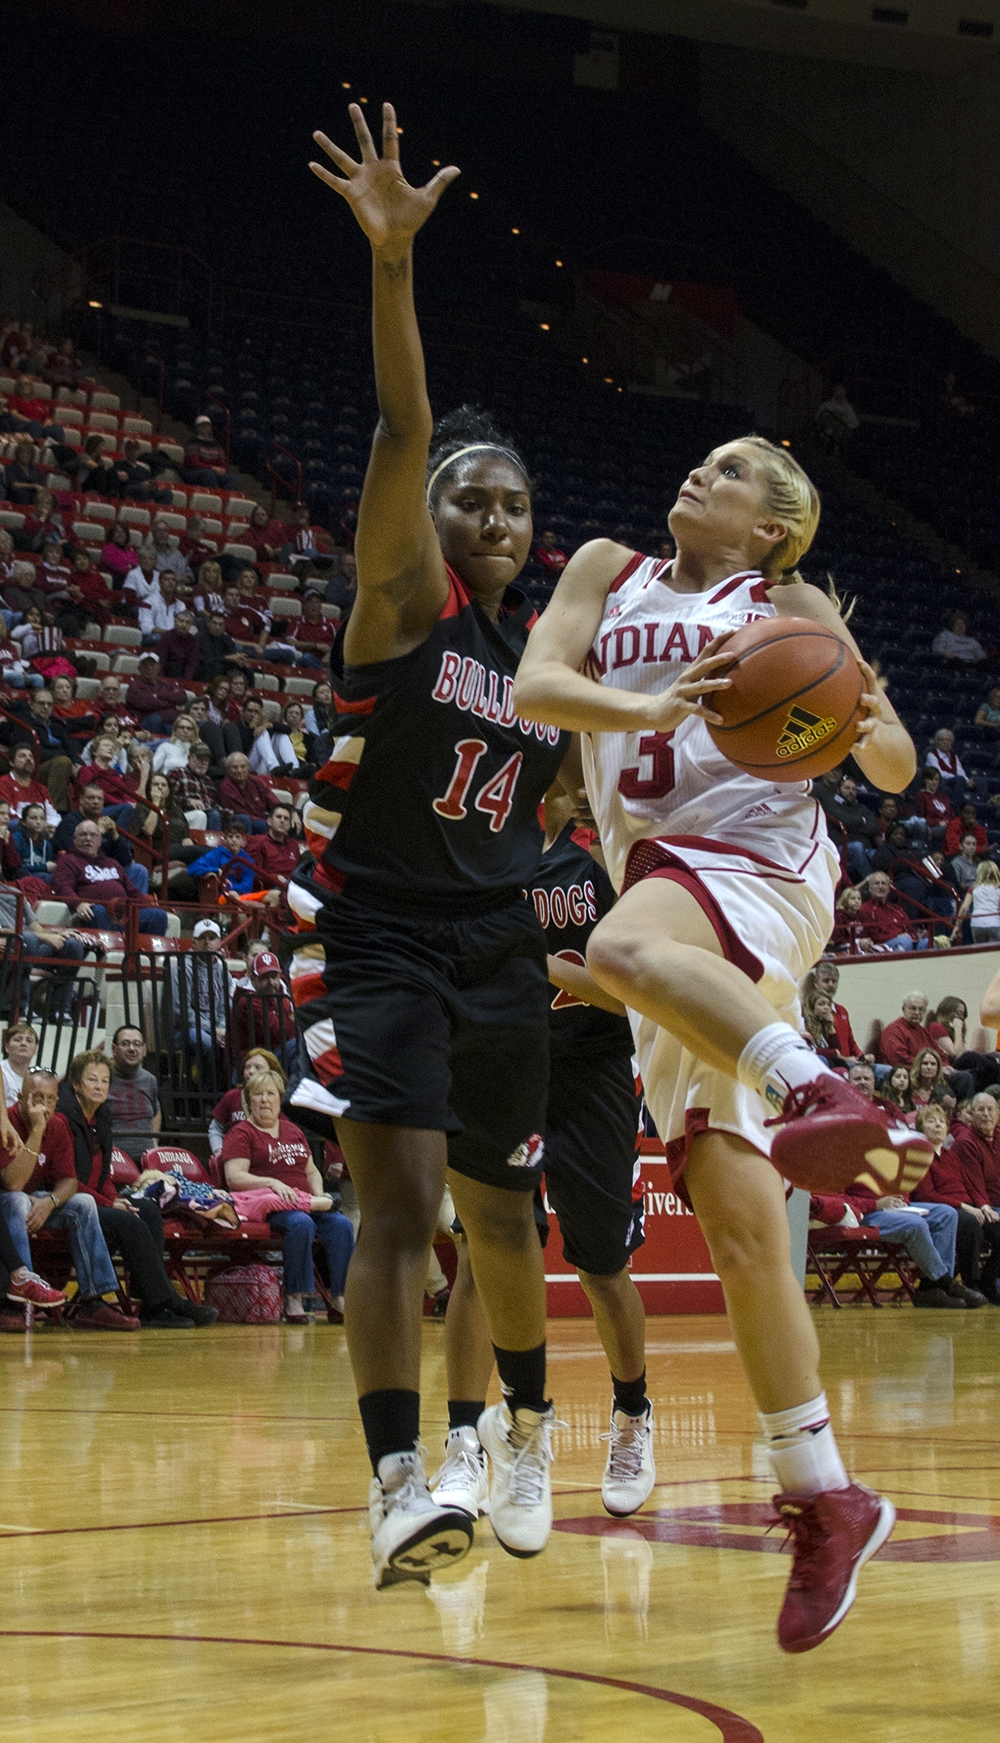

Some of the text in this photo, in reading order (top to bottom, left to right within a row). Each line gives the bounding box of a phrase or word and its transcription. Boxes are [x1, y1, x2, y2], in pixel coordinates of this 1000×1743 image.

[775, 717, 838, 758] adidas
[618, 729, 676, 799] 3
[432, 738, 524, 833] 14
[157, 1151, 194, 1165] INDIANA
[642, 1180, 696, 1216] iver
